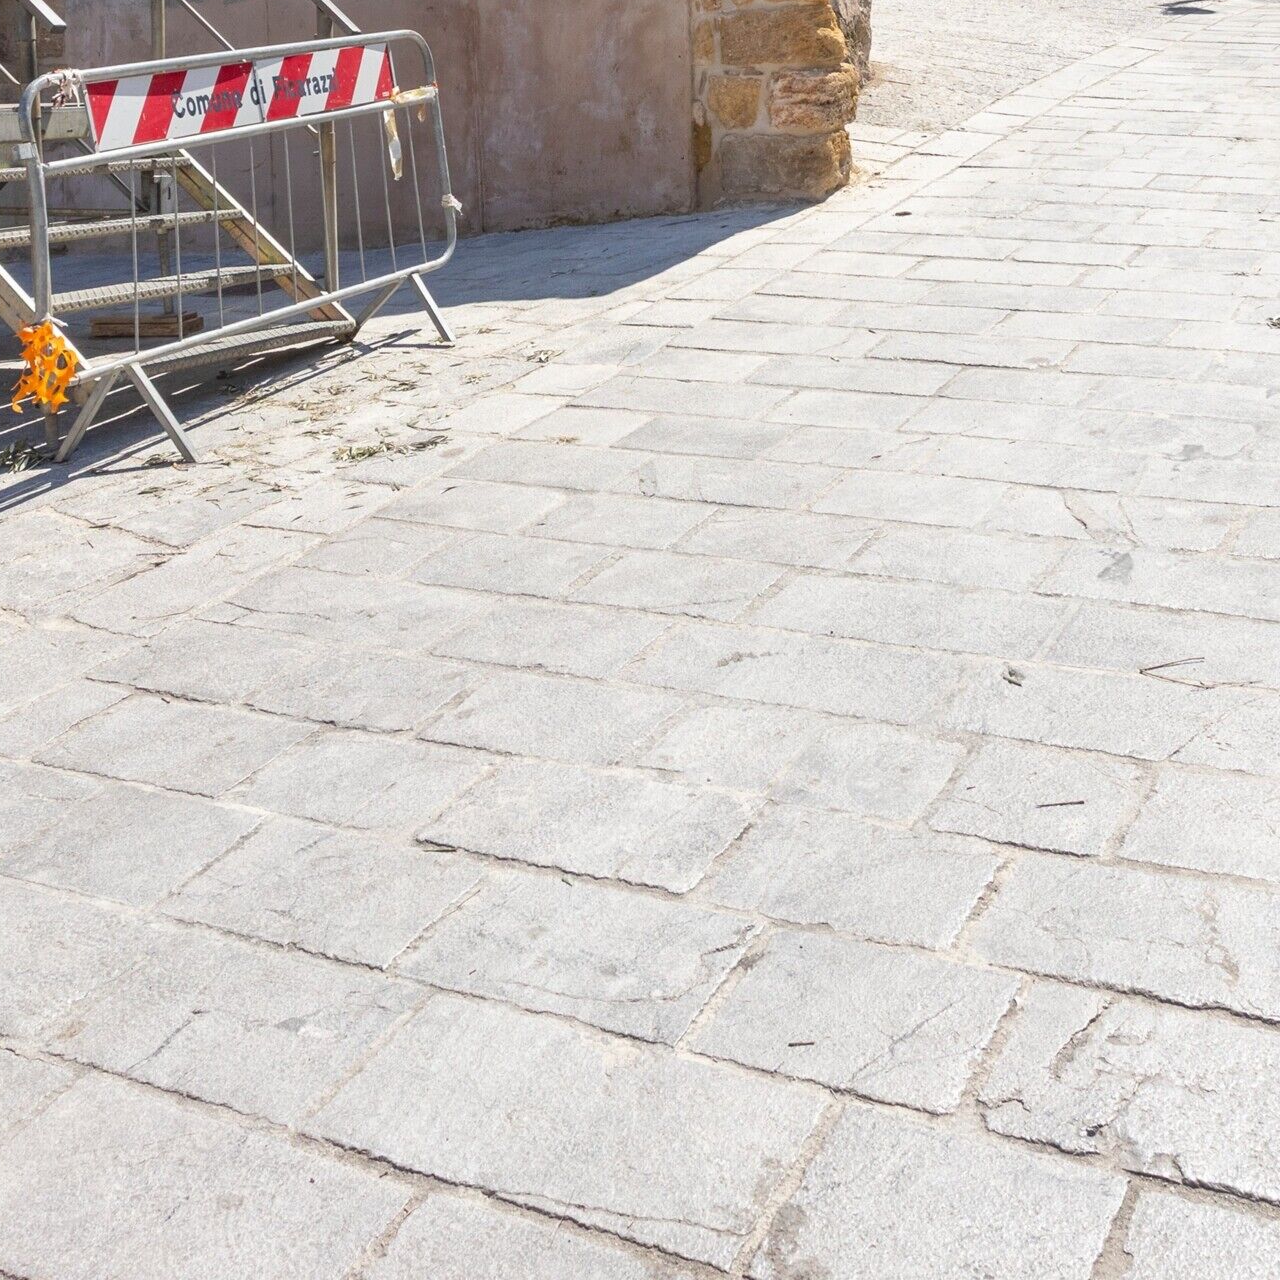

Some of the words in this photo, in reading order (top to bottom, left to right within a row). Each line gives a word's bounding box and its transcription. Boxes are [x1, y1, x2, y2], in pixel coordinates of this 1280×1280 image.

[171, 89, 243, 119] Comune
[250, 71, 267, 106] di
[272, 67, 339, 102] Ficarazzi
